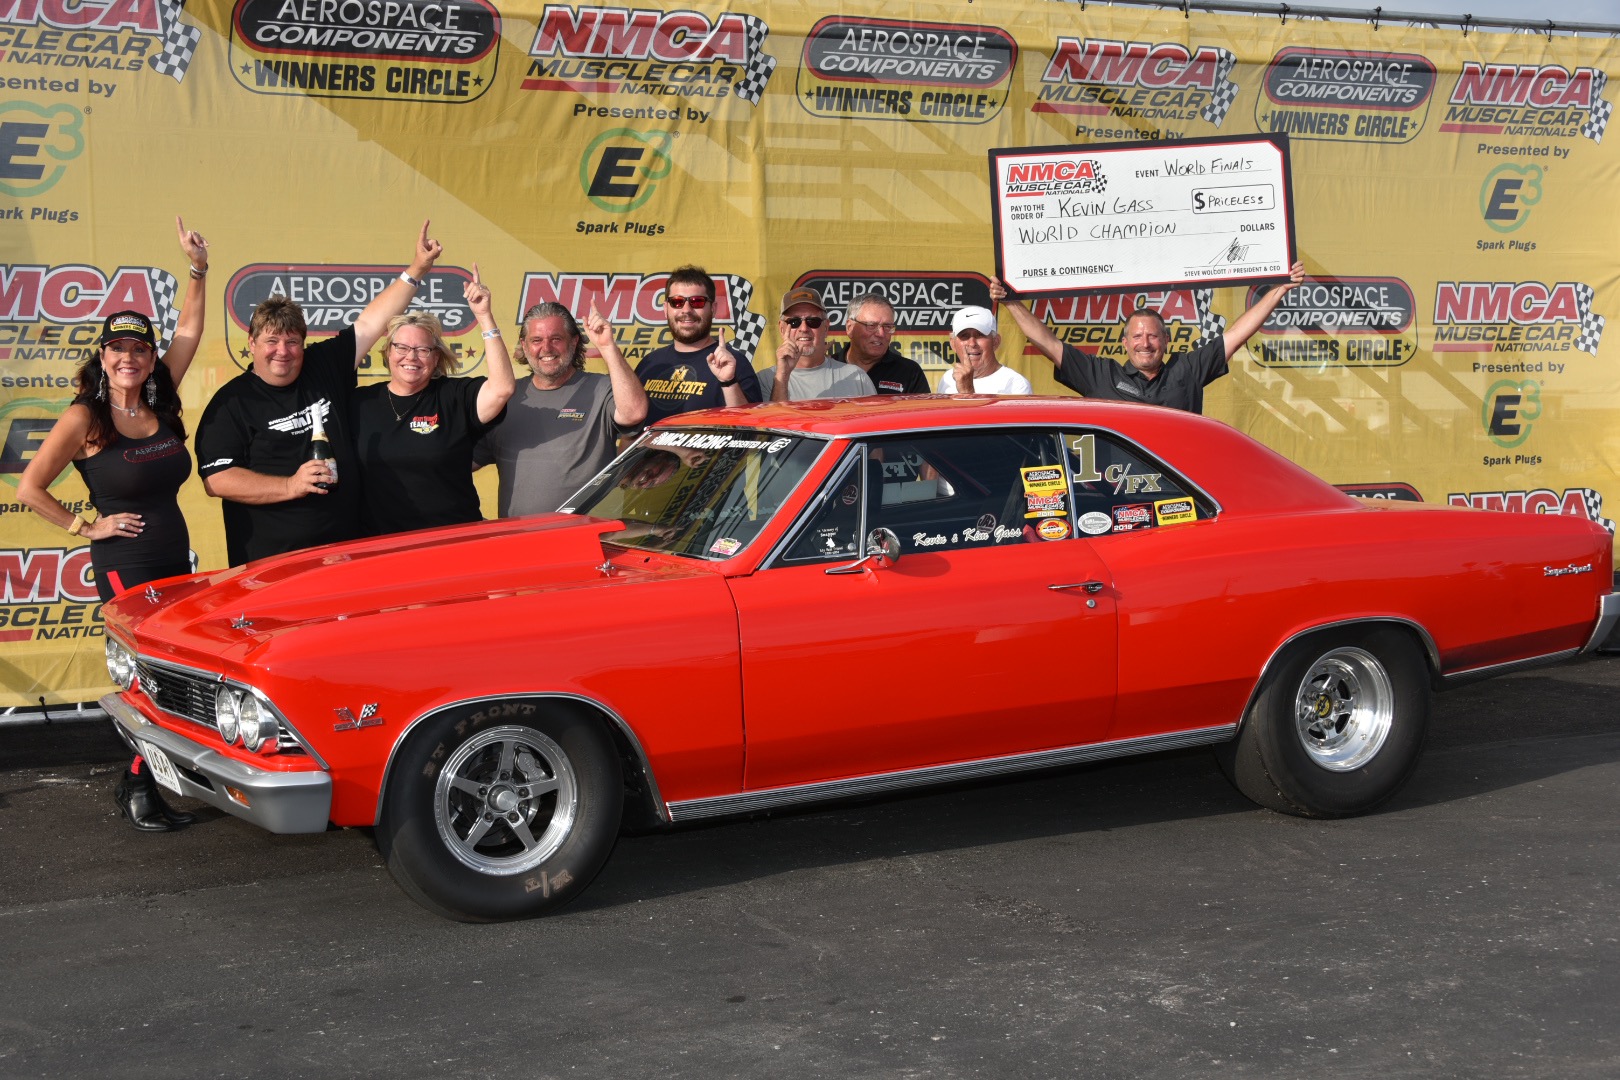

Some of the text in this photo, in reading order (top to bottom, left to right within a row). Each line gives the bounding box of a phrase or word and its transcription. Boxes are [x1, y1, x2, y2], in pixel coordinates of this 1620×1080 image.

[276, 0, 460, 31] AEROSPACE
[255, 24, 477, 54] COMPONENTS
[528, 4, 750, 64] NMCA
[839, 28, 987, 59] AEROSPACE
[65, 32, 152, 57] CAR
[7, 51, 144, 72] NATIONALS
[819, 55, 996, 80] COMPONENTS
[1040, 36, 1221, 92] NMCA
[1293, 57, 1413, 84] AEROSPACE
[254, 59, 471, 97] WINNERS CIRCLE
[526, 59, 738, 85] MUSCLE CAR
[88, 79, 117, 97] by
[618, 82, 730, 98] NATIONALS
[1275, 82, 1418, 103] COMPONENTS
[1448, 61, 1594, 109] NMCA
[815, 86, 988, 118] WINNERS CIRCLE
[1037, 85, 1207, 109] MUSCLE CAR
[573, 103, 710, 123] Presented by
[1110, 106, 1198, 120] NATIONALS
[1444, 106, 1584, 127] MUSCLE CAR
[1075, 125, 1161, 140] Presented
[1269, 110, 1409, 138] WINNERS CIRCLE
[1501, 125, 1579, 137] NATIONALS
[1477, 143, 1570, 159] Presented by
[584, 128, 672, 200] E3
[1006, 160, 1098, 185] NMCA
[1135, 169, 1159, 178] EVENT
[1007, 180, 1092, 193] MUSCLE CAR
[1483, 163, 1543, 222] E3
[30, 207, 79, 223] Plugs
[1010, 204, 1045, 213] PAY TO THE
[1112, 197, 1154, 214] GASS
[1010, 212, 1044, 221] ORDER OF
[576, 220, 665, 236] Spark Plugs
[1240, 222, 1275, 232] DOLLARS
[1476, 239, 1537, 252] Spark Plugs
[1022, 264, 1114, 277] PURSE & CONTINGENCY
[1184, 269, 1201, 277] STEVE
[1233, 266, 1262, 274] PRESIDENT
[1432, 281, 1582, 326] NMCA
[1264, 311, 1402, 327] COMPONENTS
[1434, 325, 1575, 341] MUSCLE CAR
[1262, 339, 1402, 362] WINNERS CIRCLE
[1494, 342, 1571, 353] NATIONALS
[1473, 361, 1565, 374] Presented by
[644, 379, 708, 396] MURRAY STATE
[649, 392, 691, 401] BASKETBALL
[1488, 379, 1542, 436] E3
[681, 433, 733, 450] RACING
[1073, 434, 1101, 482] 1
[1483, 455, 1542, 467] Spark Plugs
[1104, 463, 1162, 495] C/FX
[1028, 496, 1059, 506] NMCA
[1118, 508, 1147, 518] NMCA
[913, 532, 947, 547] Kevin
[994, 525, 1022, 543] Gass
[454, 703, 537, 735] FRONT
